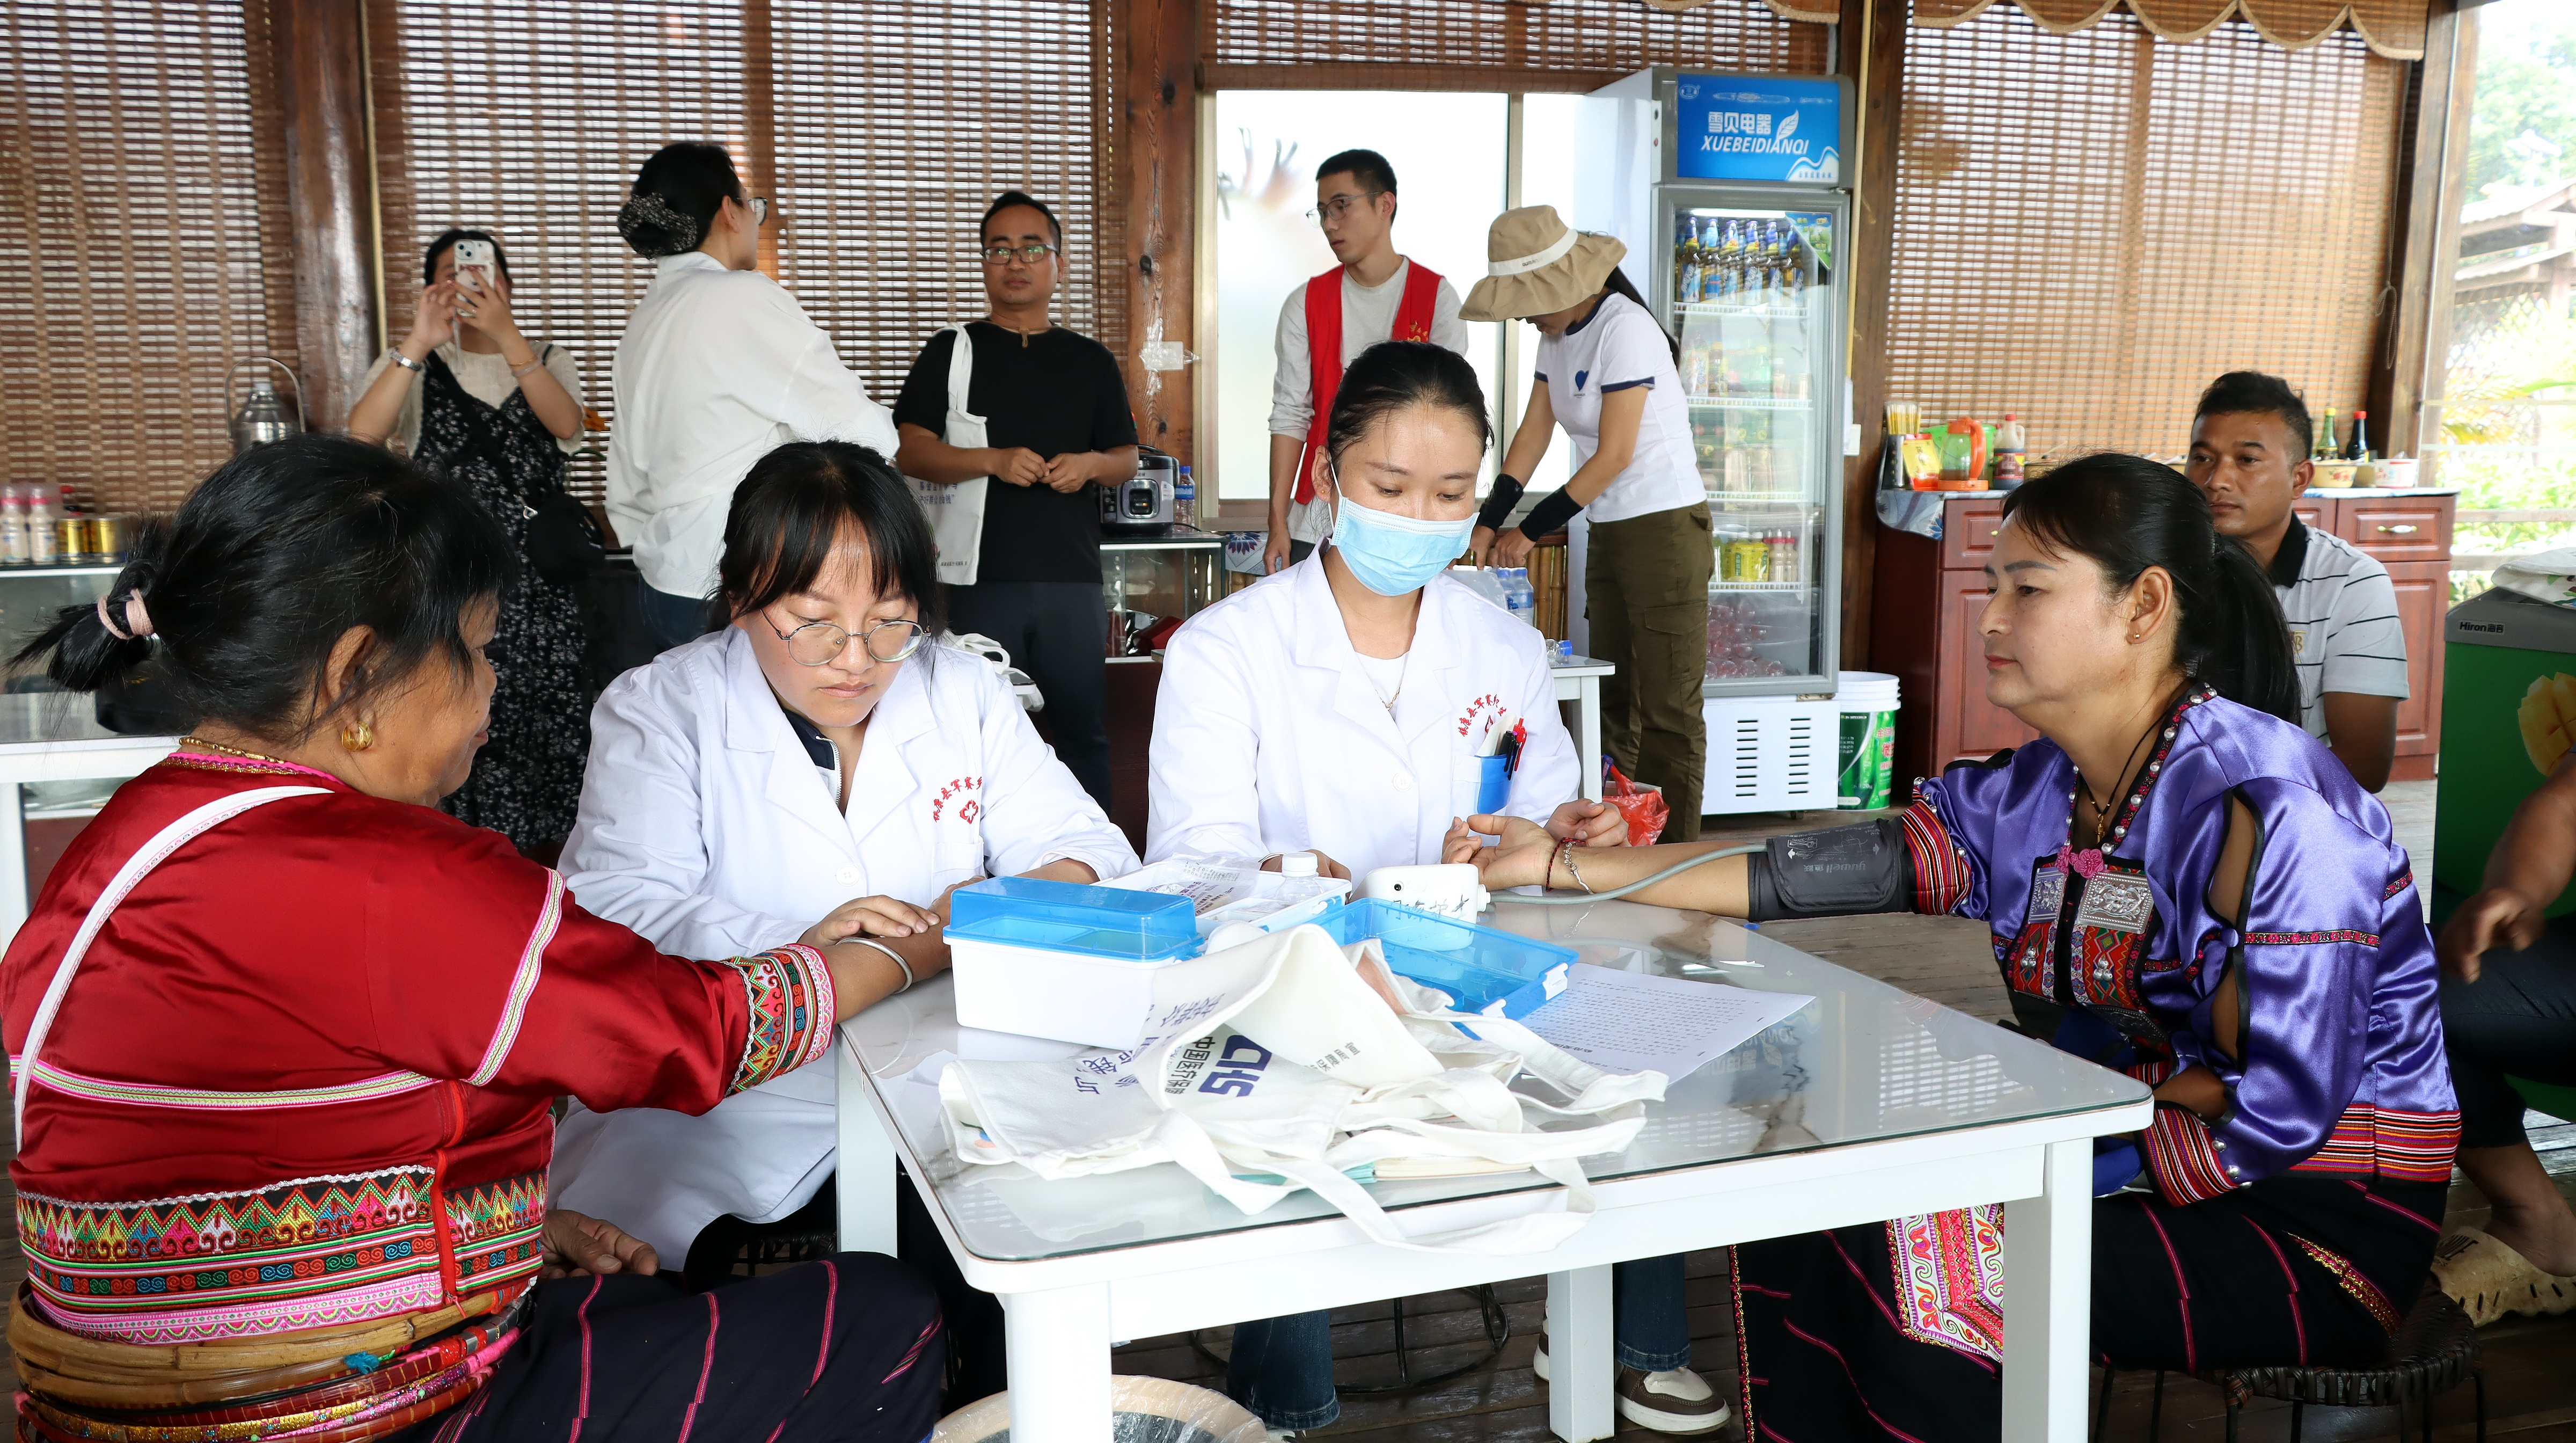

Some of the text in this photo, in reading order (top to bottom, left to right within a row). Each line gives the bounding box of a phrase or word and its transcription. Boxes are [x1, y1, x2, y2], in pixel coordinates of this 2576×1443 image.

[1708, 111, 1772, 135] 雪贝电器
[1701, 135, 1809, 155] XUEBEIDIANQI
[2460, 622, 2486, 632] Hiron
[1803, 861, 1866, 873] yuwell 鱼跃
[1310, 1049, 1350, 1072] 保障局
